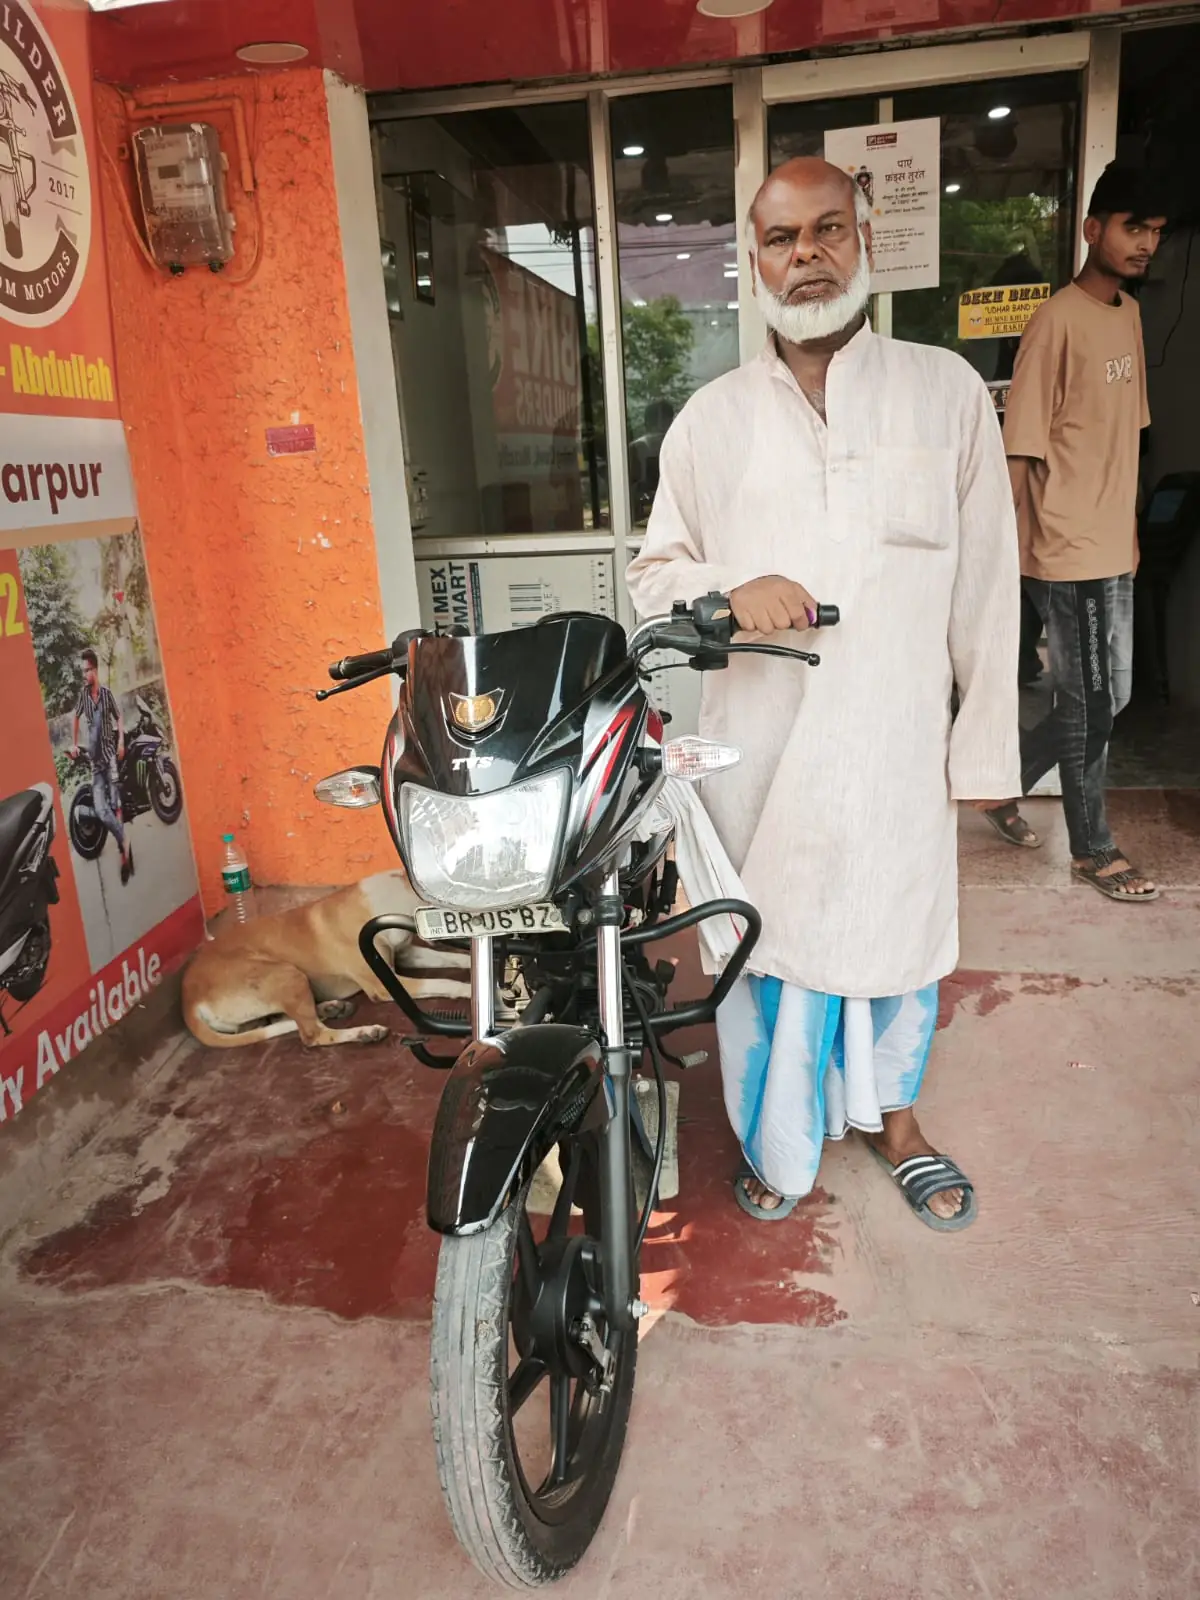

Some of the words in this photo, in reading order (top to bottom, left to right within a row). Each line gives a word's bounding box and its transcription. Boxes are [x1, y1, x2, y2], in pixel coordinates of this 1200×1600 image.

[49, 176, 75, 200] 2017
[23, 251, 71, 301] MOTORS
[961, 291, 1004, 306] DEKH
[1008, 287, 1048, 302] BHAI
[10, 343, 114, 402] Abdullah
[1, 462, 102, 515] arpur
[451, 756, 494, 771] TVS
[443, 911, 473, 934] BR
[481, 910, 513, 930] 06
[37, 947, 162, 1089] Available
